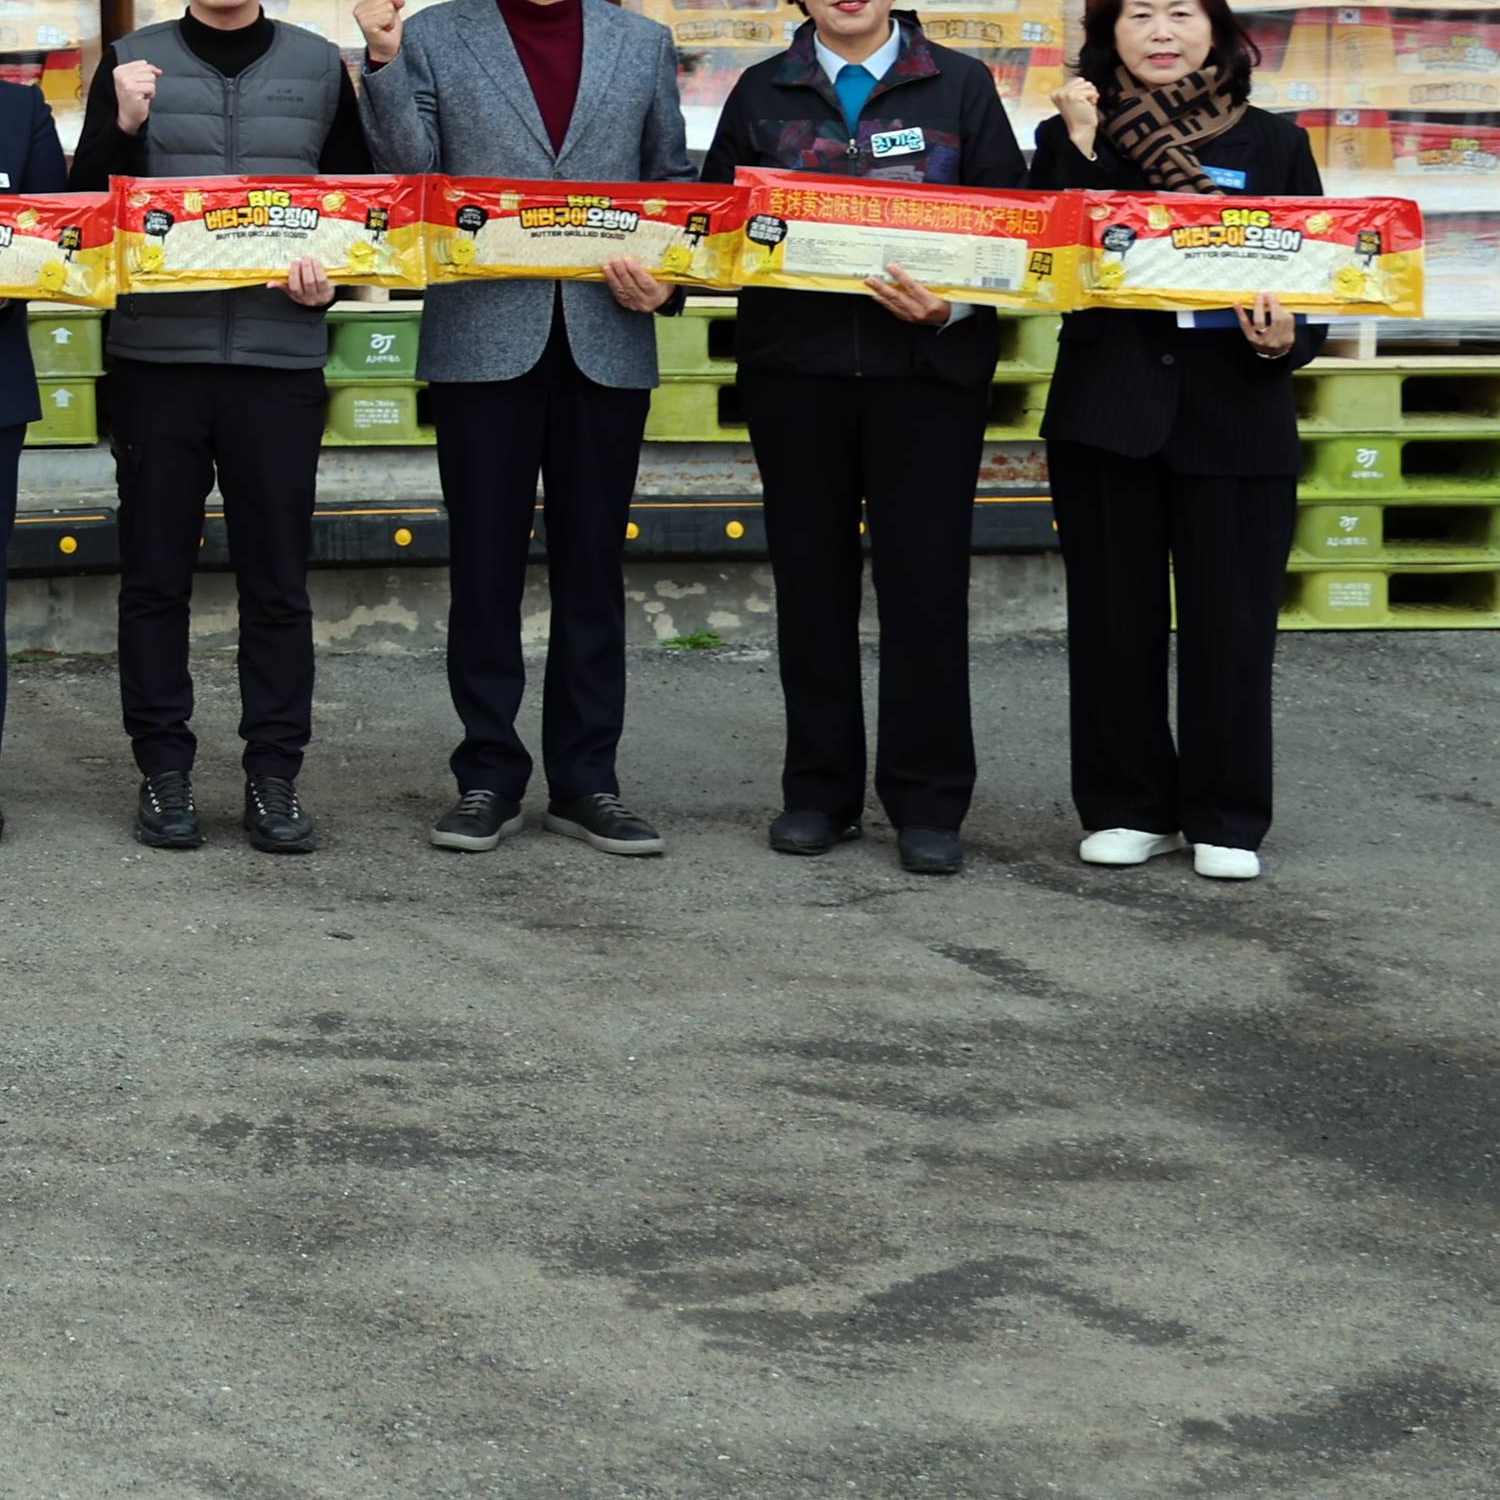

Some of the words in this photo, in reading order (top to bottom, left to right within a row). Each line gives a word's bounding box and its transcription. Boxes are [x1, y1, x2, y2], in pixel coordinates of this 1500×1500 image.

[247, 189, 291, 208] BIG
[203, 206, 320, 232] 버터구이오징어
[519, 206, 640, 232] 버터구이오징어
[1220, 208, 1273, 229] BIG
[1171, 226, 1302, 253] 버터구이오징어
